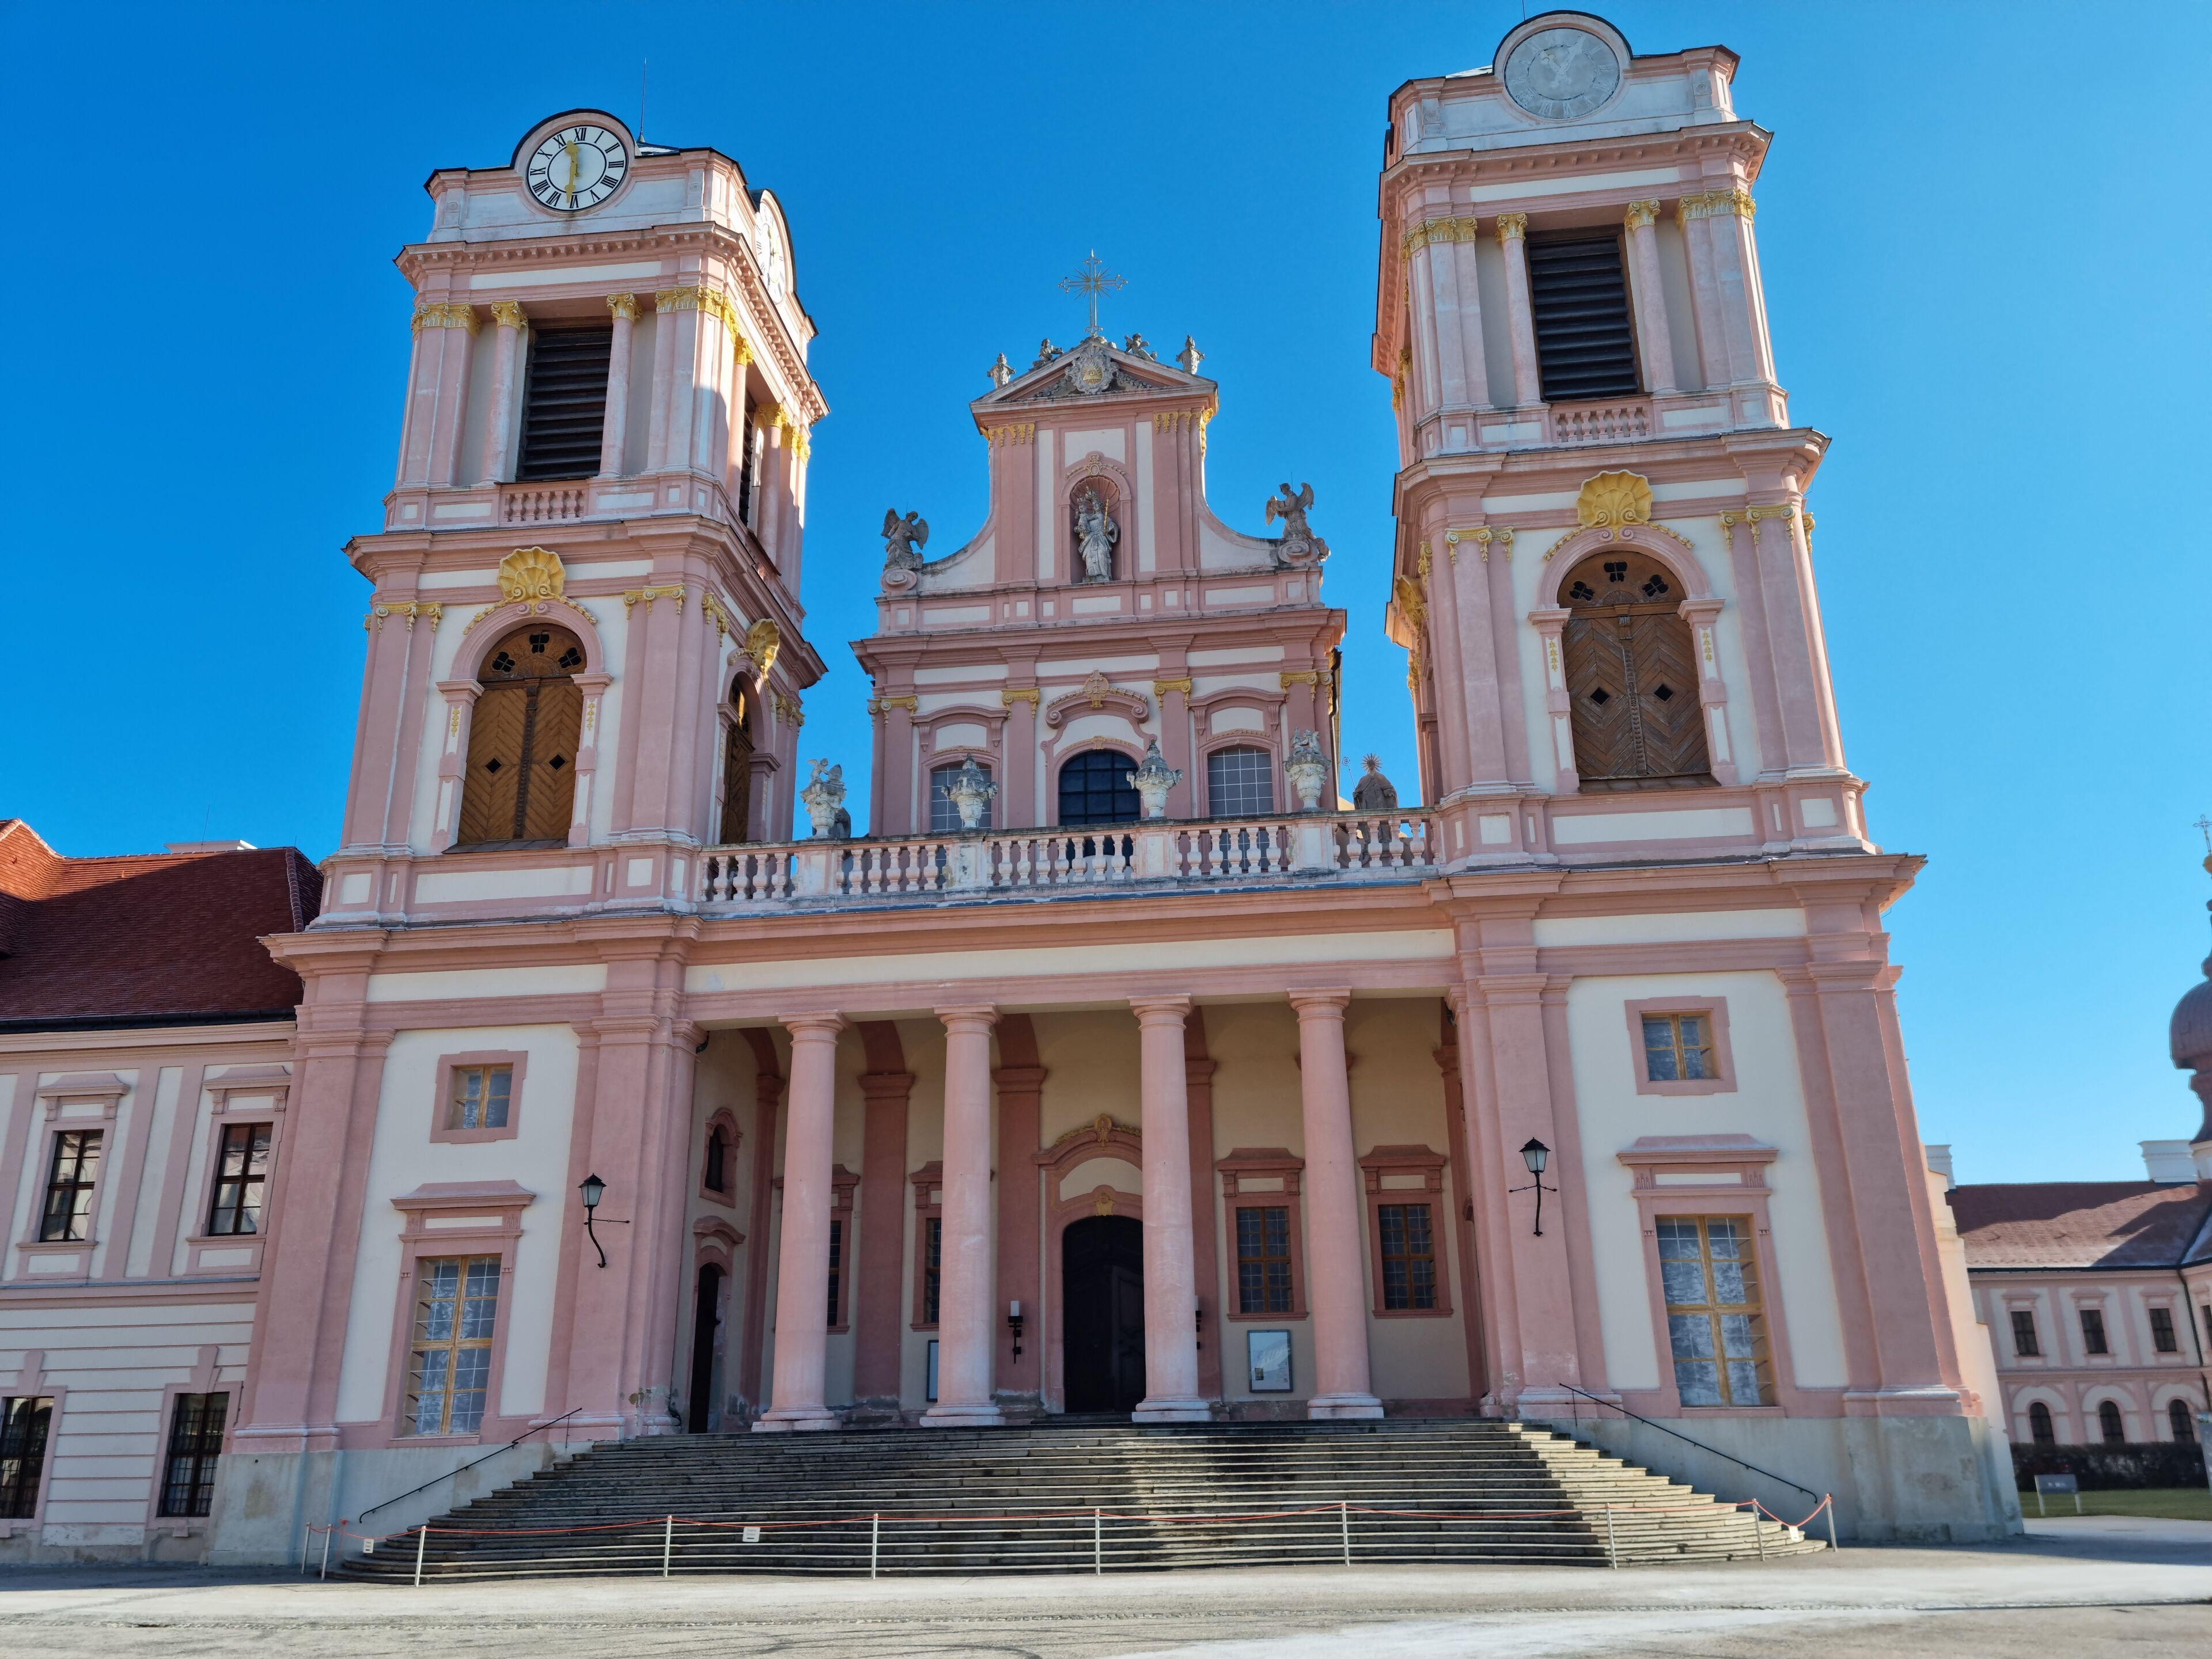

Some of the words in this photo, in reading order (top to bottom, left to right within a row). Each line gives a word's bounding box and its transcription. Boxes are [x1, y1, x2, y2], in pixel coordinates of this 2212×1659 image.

[553, 133, 567, 149] XI
[574, 127, 587, 142] XII
[594, 130, 604, 143] I
[537, 149, 553, 160] X
[604, 142, 620, 154] II
[530, 166, 546, 176] IX
[608, 160, 624, 168] III
[532, 179, 551, 197] VIII
[600, 175, 619, 189] IIII
[546, 191, 562, 207] VII
[569, 195, 579, 209] VI
[590, 189, 601, 203] V
